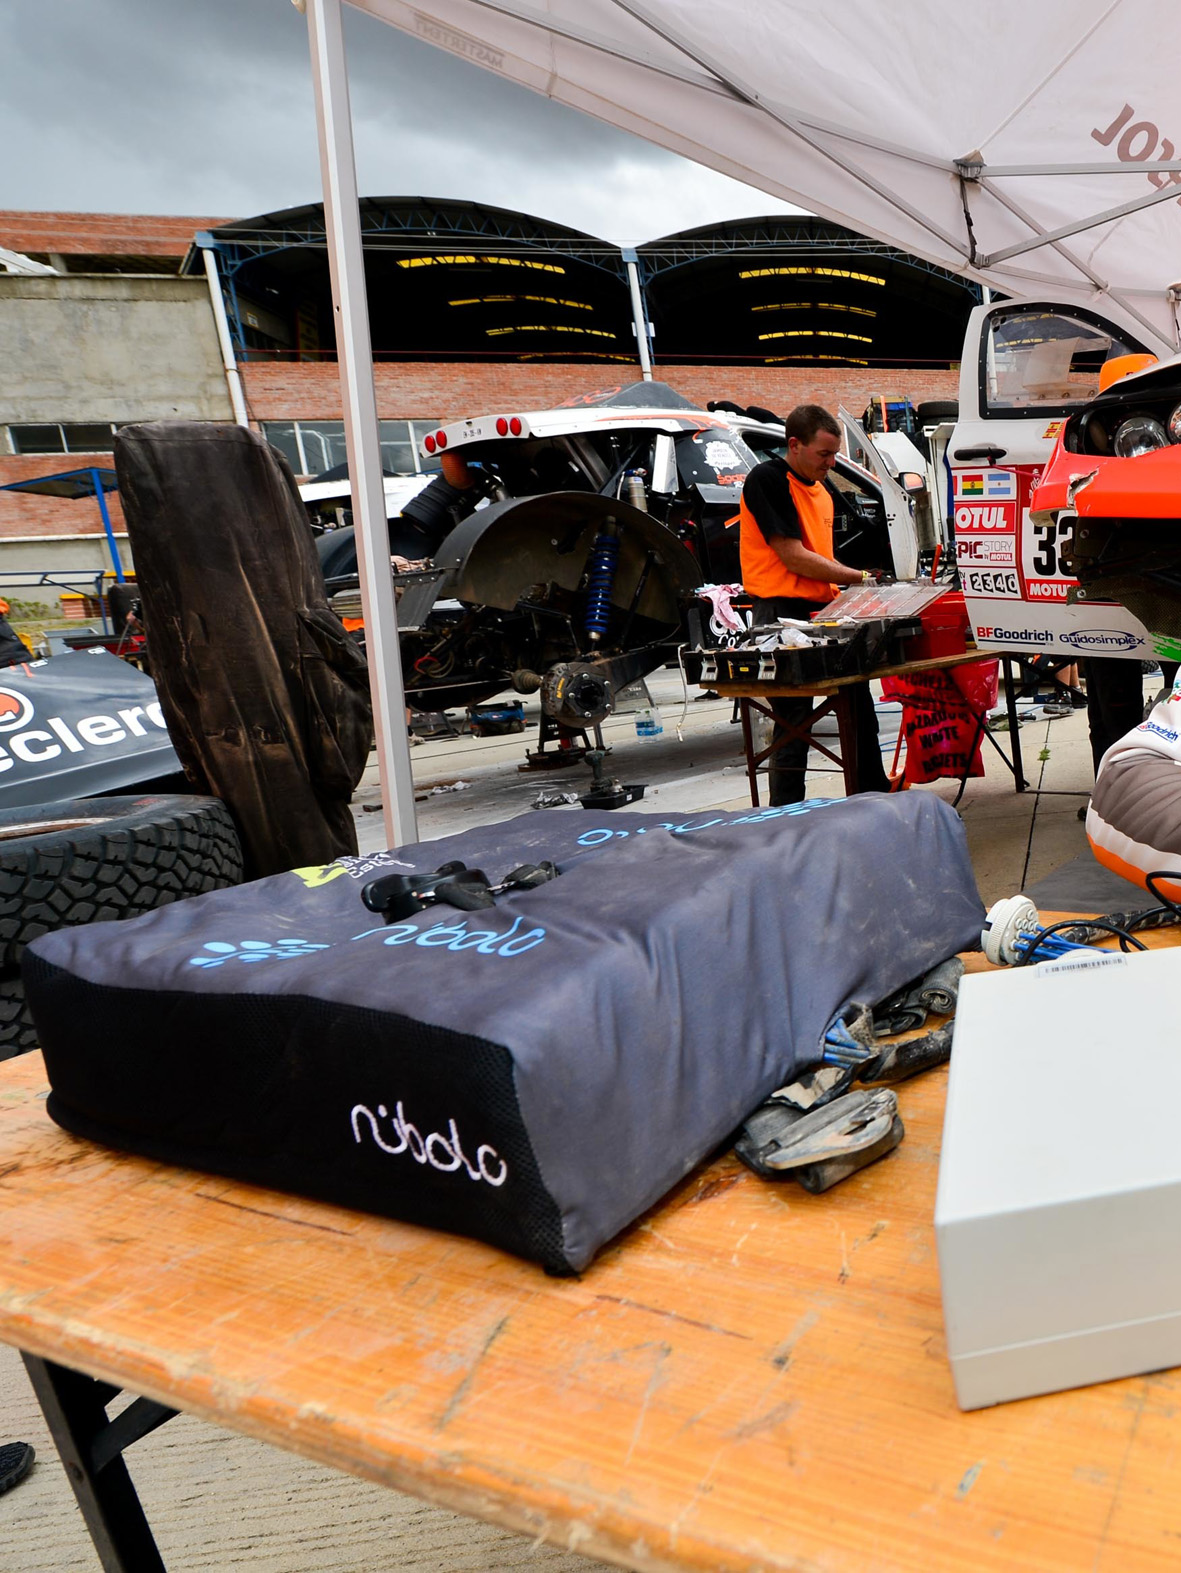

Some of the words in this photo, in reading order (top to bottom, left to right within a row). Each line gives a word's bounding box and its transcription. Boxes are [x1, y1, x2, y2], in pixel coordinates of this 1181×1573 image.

[955, 507, 1007, 529] OTUL
[984, 541, 1012, 552] STORY
[1030, 583, 1071, 597] MOTU
[977, 626, 1054, 642] BFGoodrich
[1059, 633, 1146, 647] Guidosimplex
